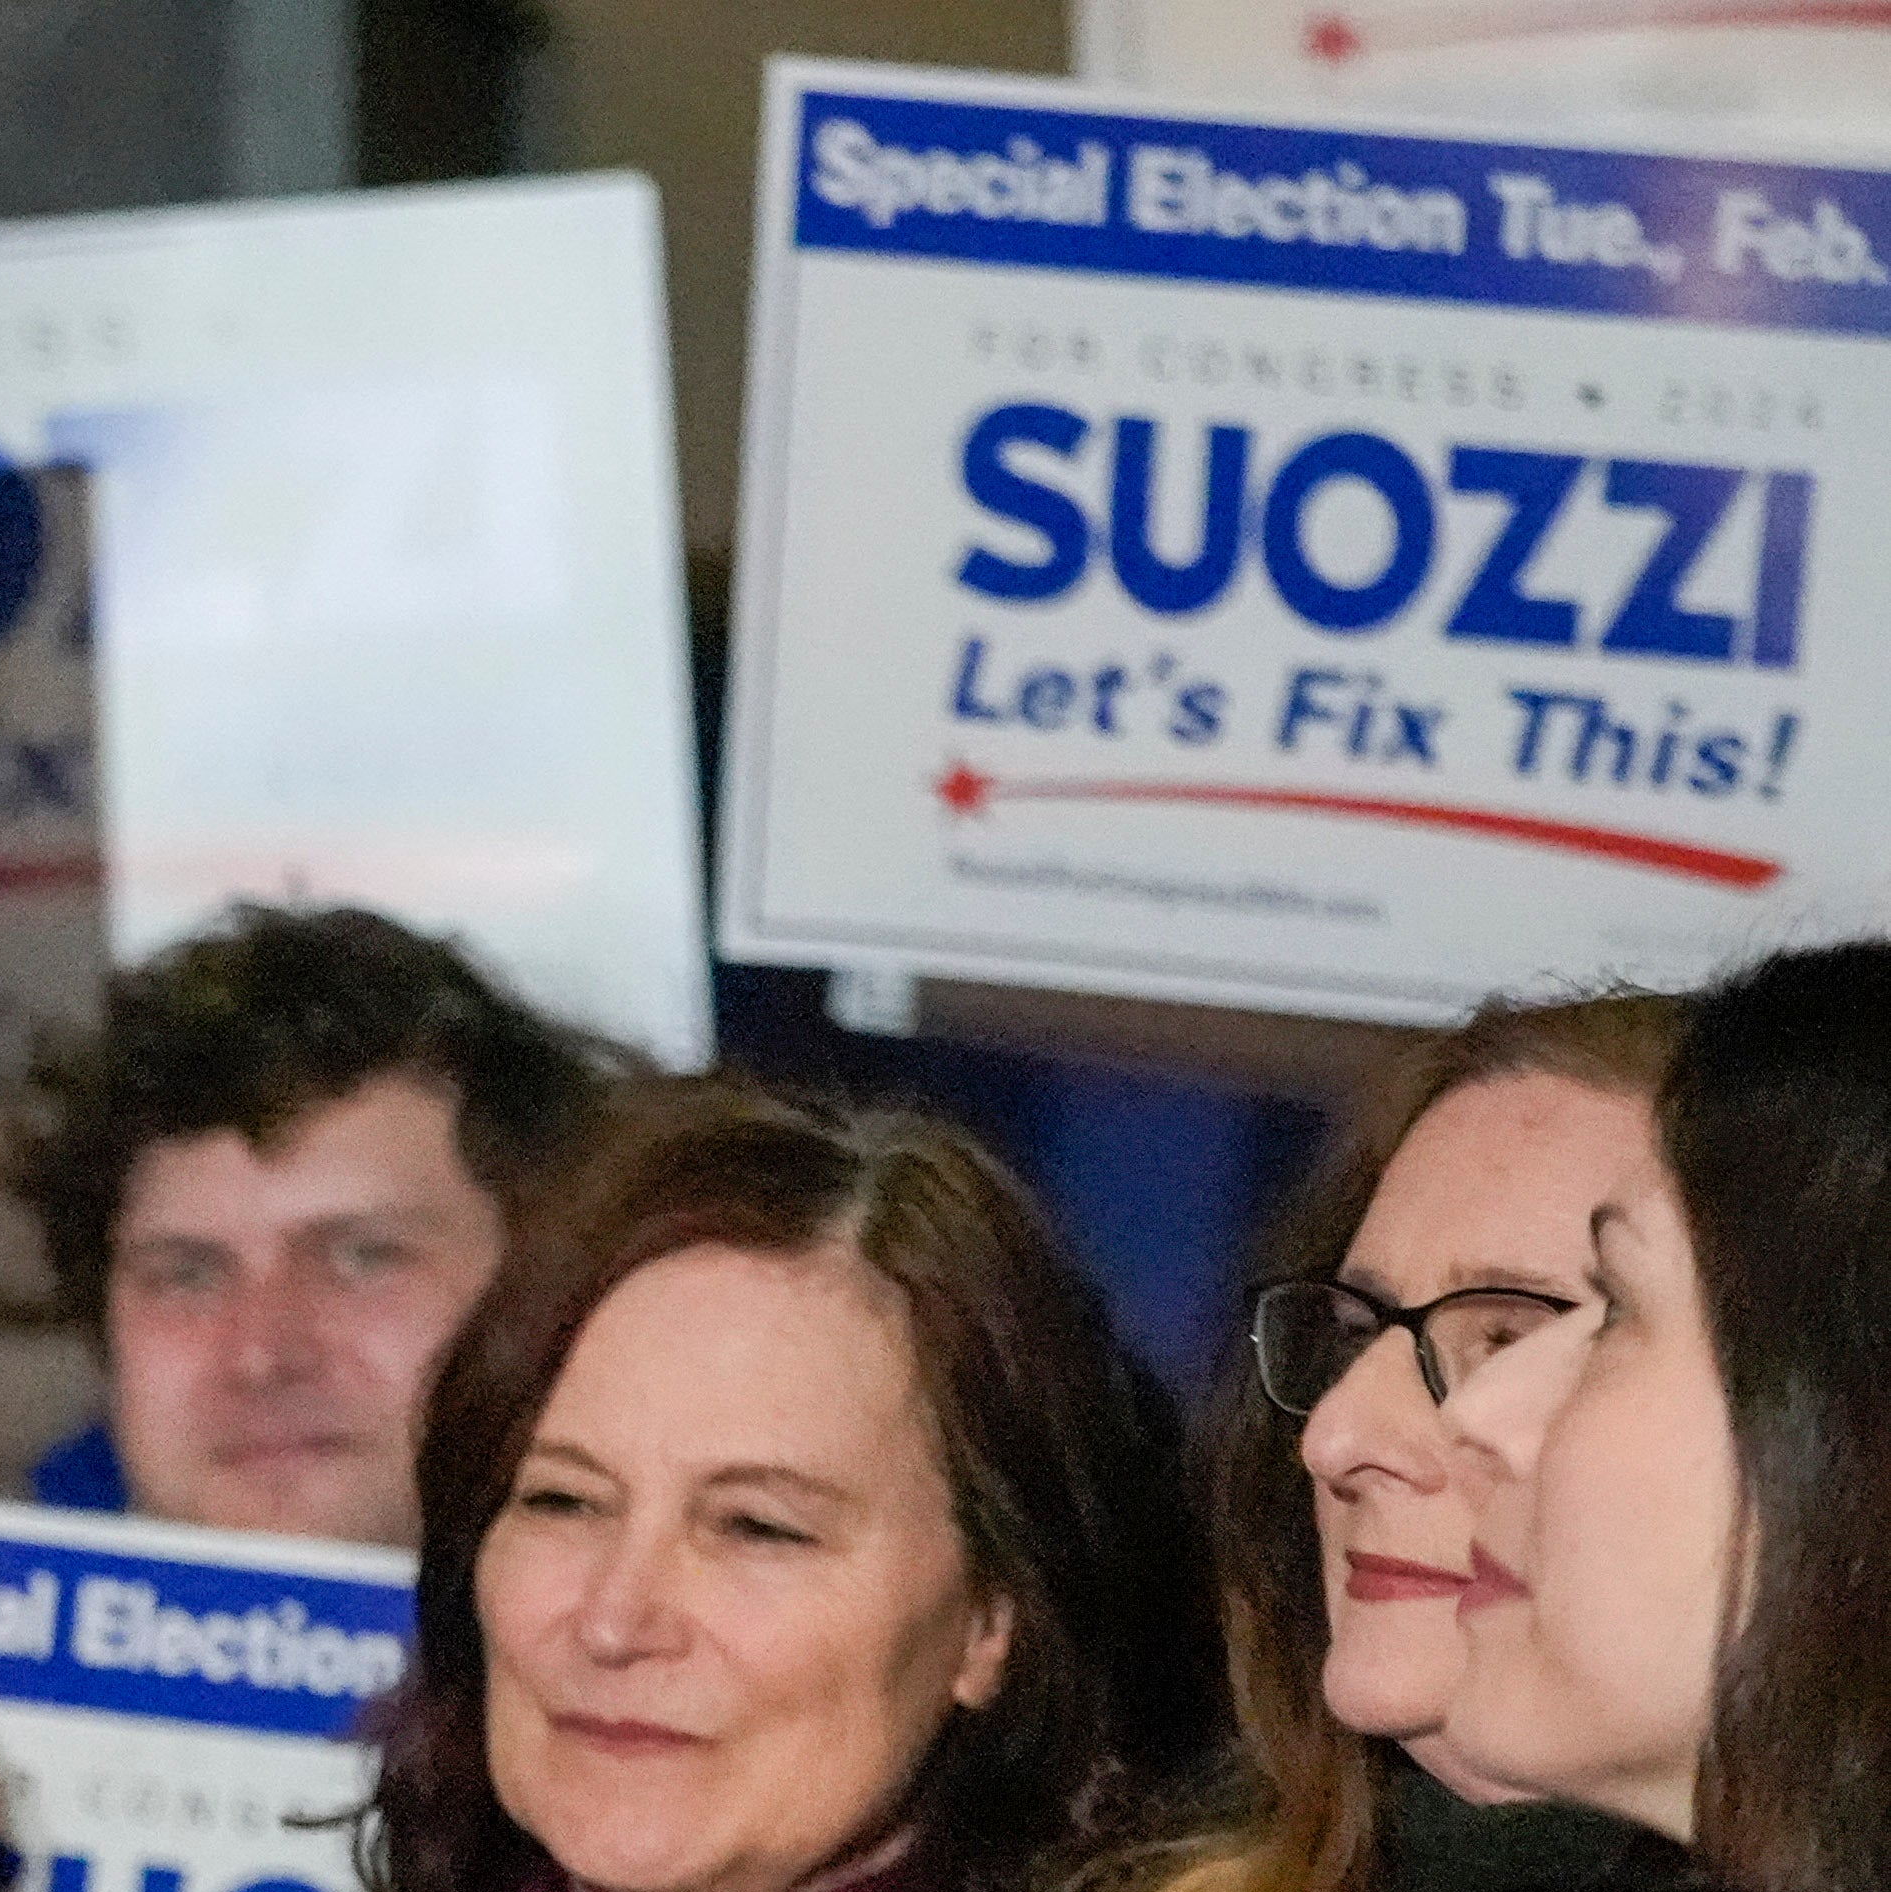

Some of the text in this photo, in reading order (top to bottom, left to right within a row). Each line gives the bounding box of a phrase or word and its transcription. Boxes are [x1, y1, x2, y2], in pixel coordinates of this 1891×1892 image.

[814, 119, 1107, 229] Special
[1129, 145, 1465, 257] Election
[954, 401, 1815, 672] SUOZZI
[949, 637, 1800, 800] Let's Fix This!
[72, 1574, 405, 1698] Election
